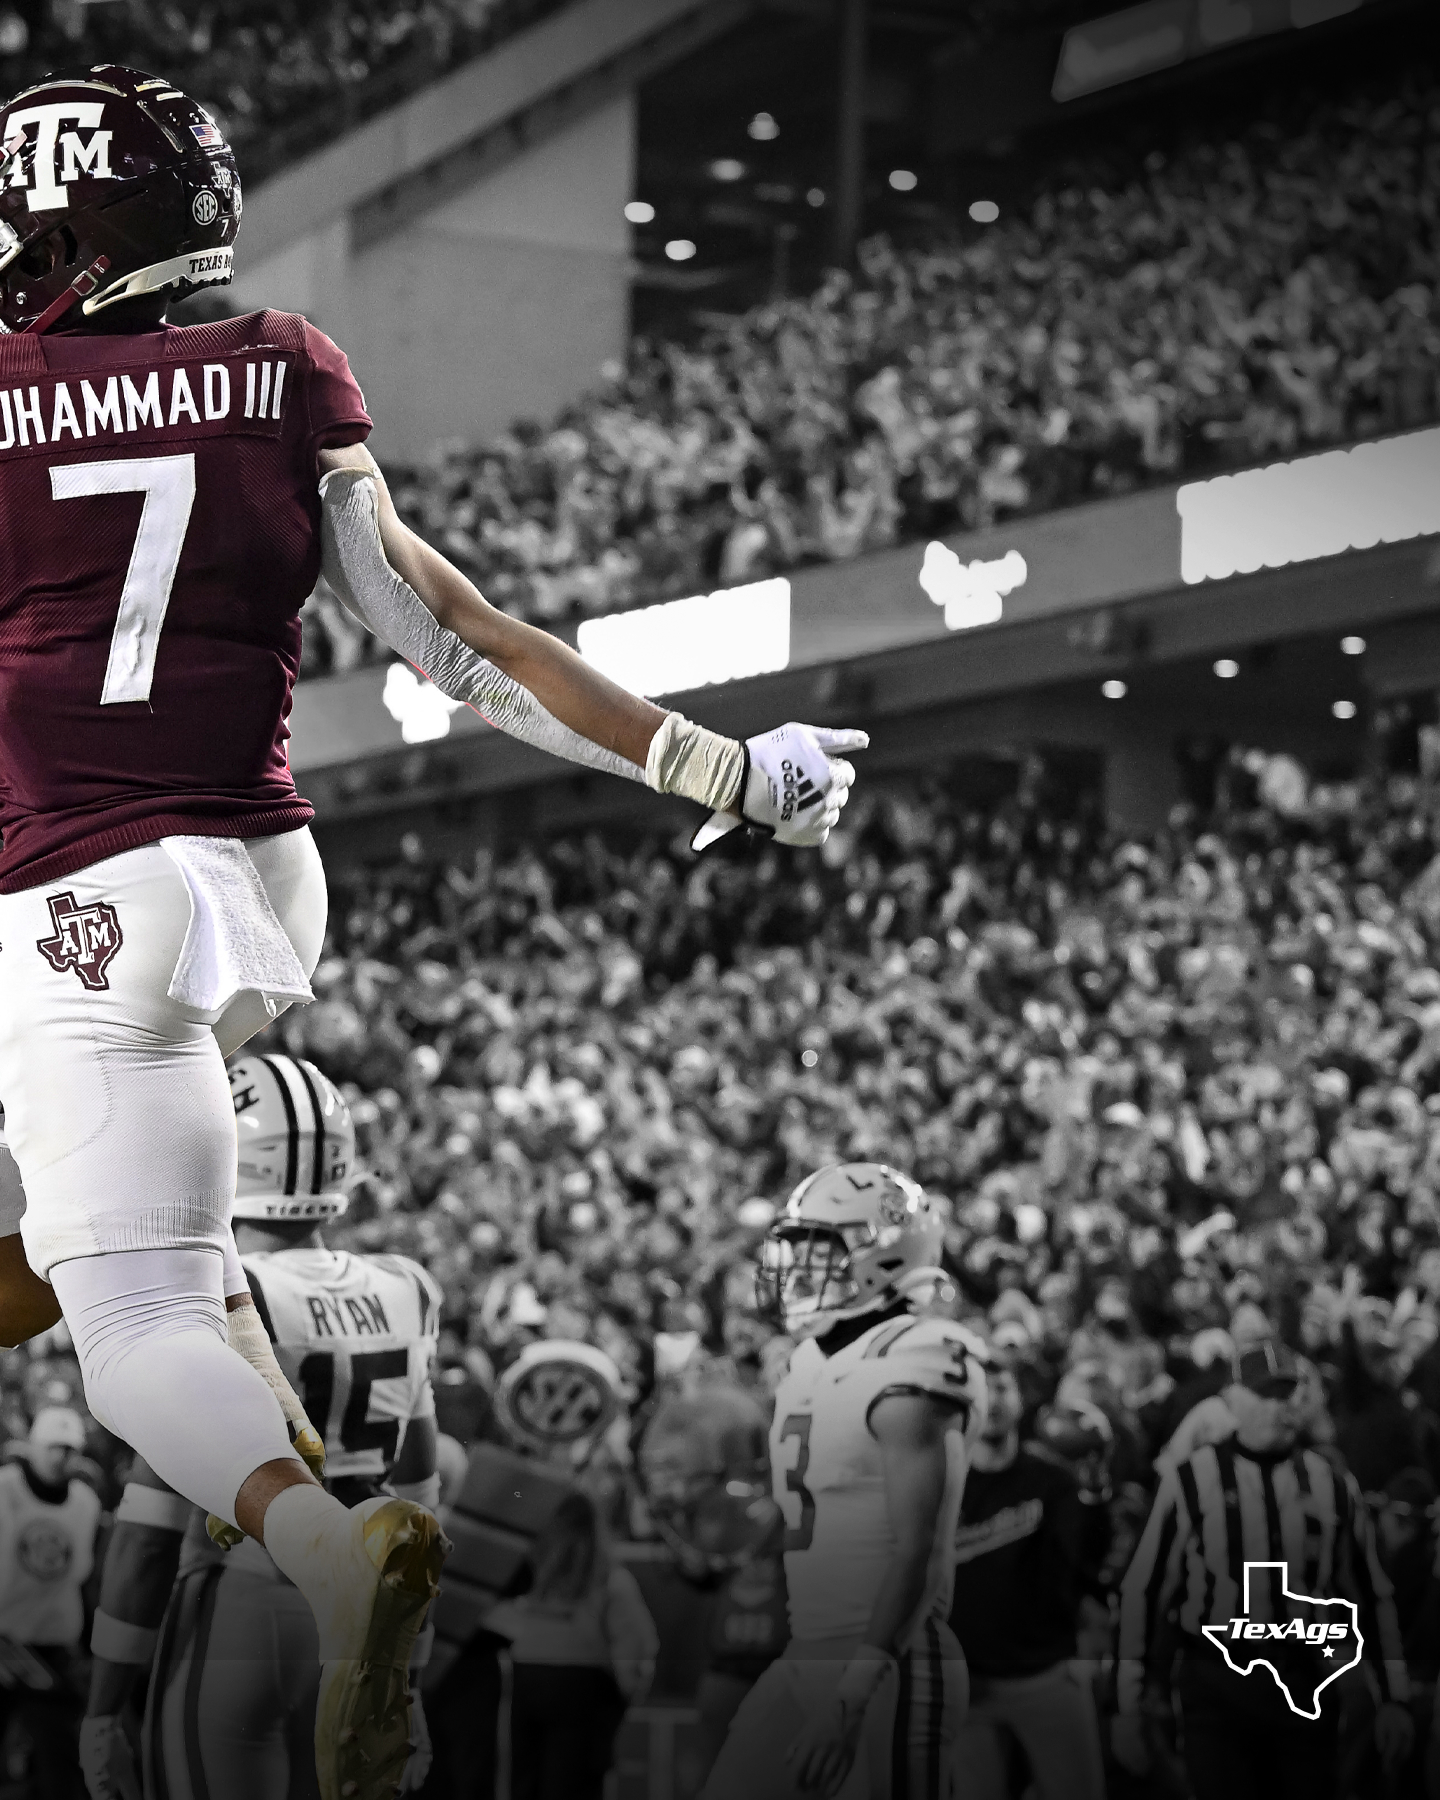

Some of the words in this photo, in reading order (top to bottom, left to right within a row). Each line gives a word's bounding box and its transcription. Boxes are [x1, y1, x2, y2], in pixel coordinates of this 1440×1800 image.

[194, 193, 216, 222] SEC
[220, 219, 229, 238] 7
[188, 254, 223, 274] TEXAS
[244, 361, 287, 419] III
[48, 452, 197, 705] 7
[780, 759, 796, 822] adidas
[307, 1293, 391, 1337] RYAN
